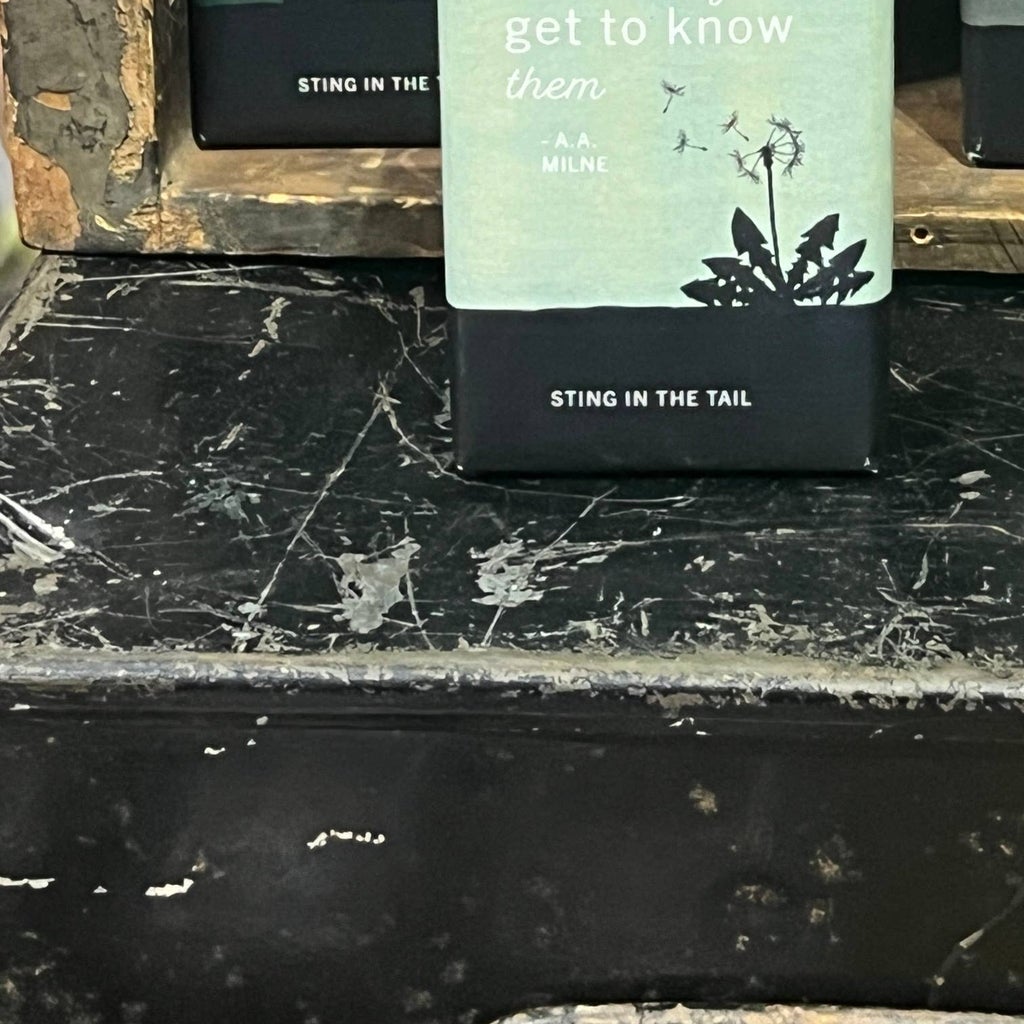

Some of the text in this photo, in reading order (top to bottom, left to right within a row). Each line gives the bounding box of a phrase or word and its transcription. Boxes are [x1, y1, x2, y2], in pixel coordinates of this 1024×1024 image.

[504, 6, 794, 54] get to know
[298, 77, 358, 93] STING
[364, 76, 385, 92] IN
[391, 75, 430, 91] THE
[505, 66, 606, 100] them
[542, 155, 609, 173] MILNE
[550, 389, 752, 408] STING IN THE TAIL
